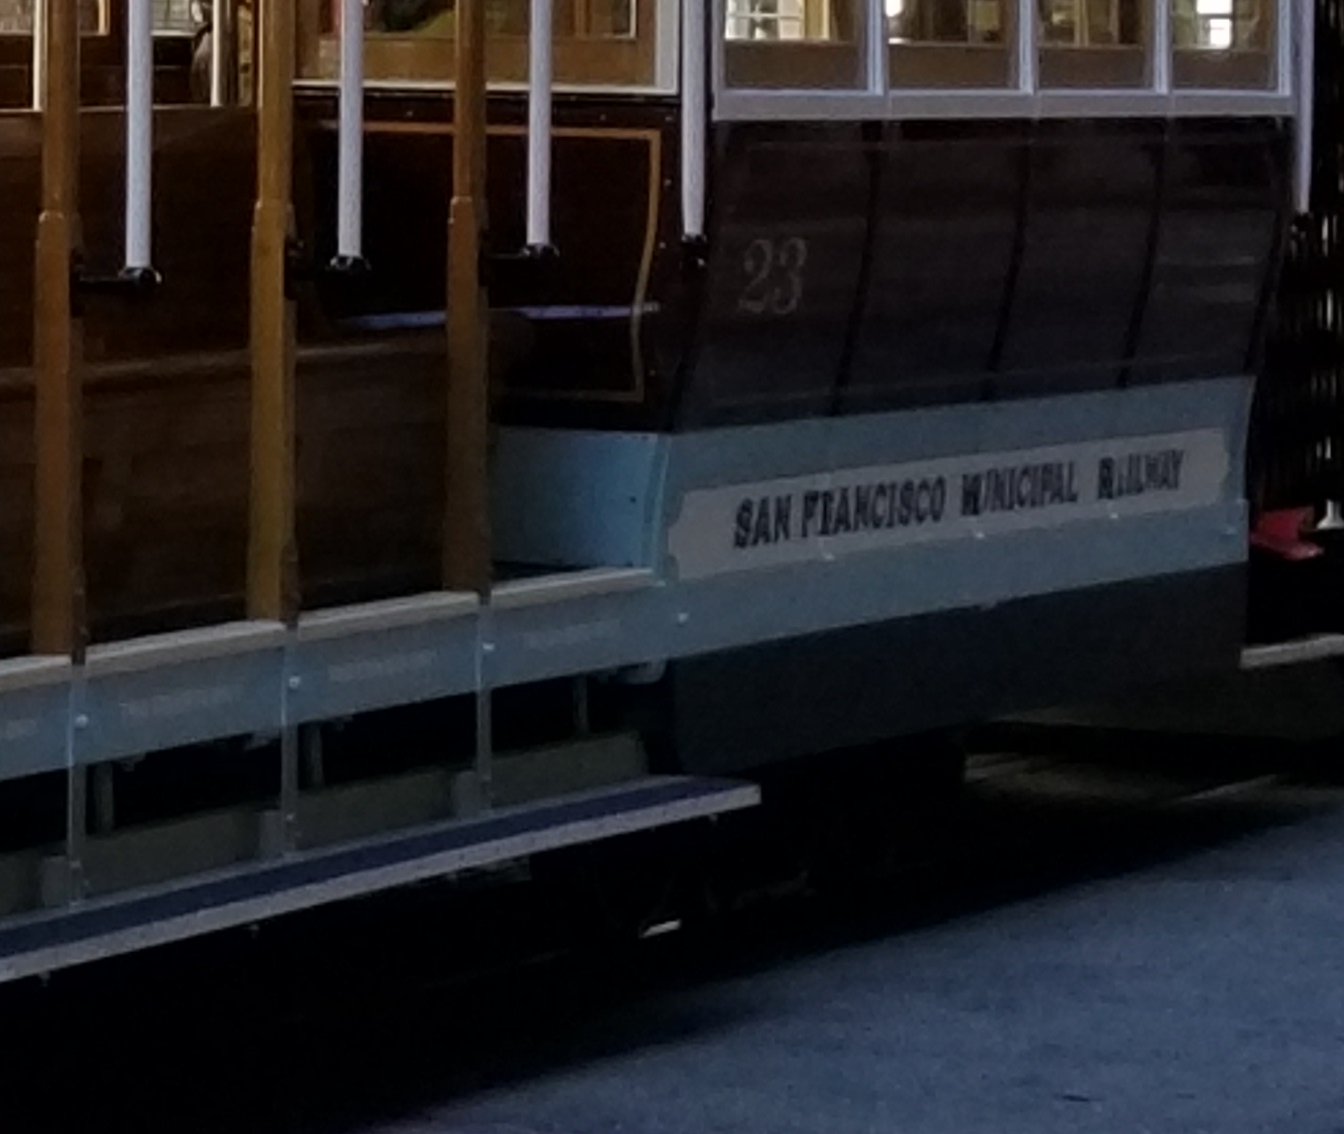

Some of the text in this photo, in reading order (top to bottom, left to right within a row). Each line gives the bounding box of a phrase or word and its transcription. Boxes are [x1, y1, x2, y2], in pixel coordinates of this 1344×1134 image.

[737, 235, 809, 316] 23
[732, 496, 792, 550] SAN
[800, 472, 947, 540] FRANCISCO
[960, 461, 1078, 517] MUNICIPAL
